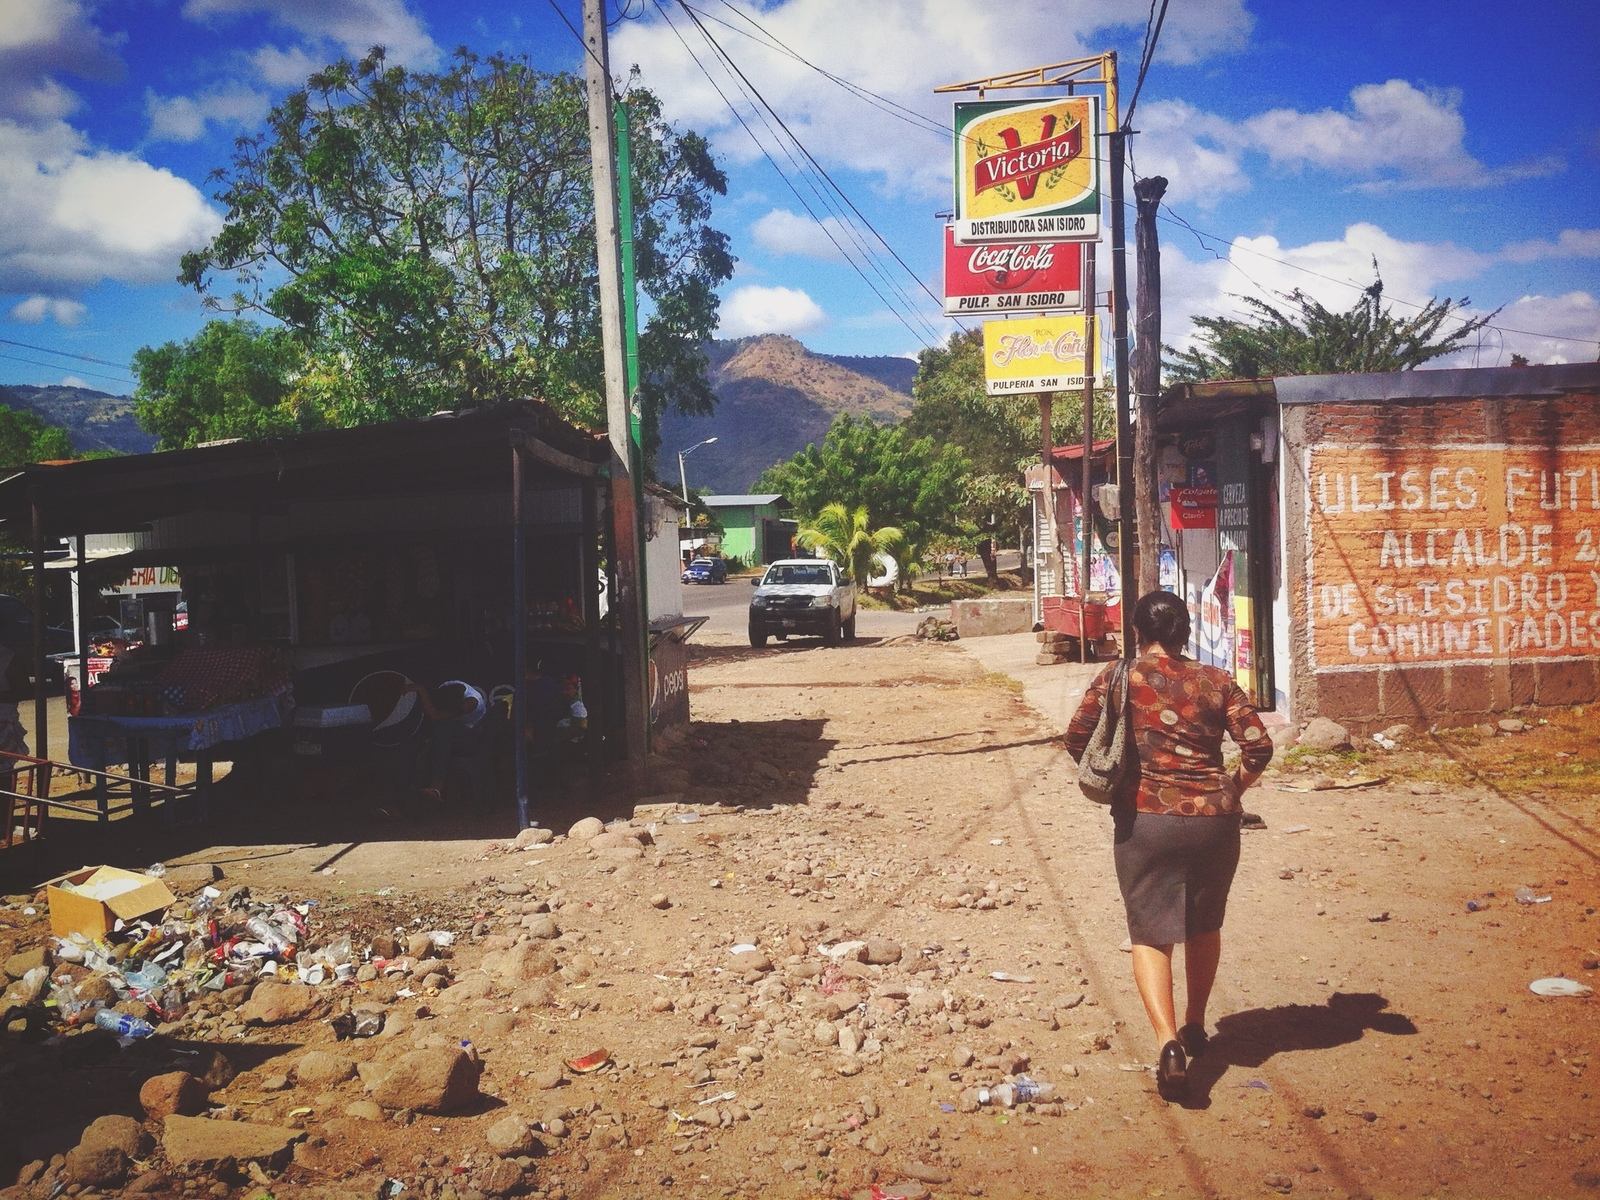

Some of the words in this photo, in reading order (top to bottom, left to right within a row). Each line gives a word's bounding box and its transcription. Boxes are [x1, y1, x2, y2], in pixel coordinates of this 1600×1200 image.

[985, 141, 1070, 181] Victoria
[971, 220, 1036, 235] DISTRIBUIDORA
[1037, 218, 1055, 232] SAN
[1056, 216, 1086, 231] ISIDRO
[968, 244, 1055, 273] Coca-Cola
[959, 297, 990, 309] PULP.
[997, 295, 1022, 307] SAN
[1026, 293, 1065, 306] ISIDRO
[993, 380, 1035, 390] PULPERIA
[1040, 379, 1058, 387] SAN
[1318, 466, 1478, 514] ULISES
[1380, 523, 1554, 570] ALCALDE
[1320, 583, 1359, 619] DE
